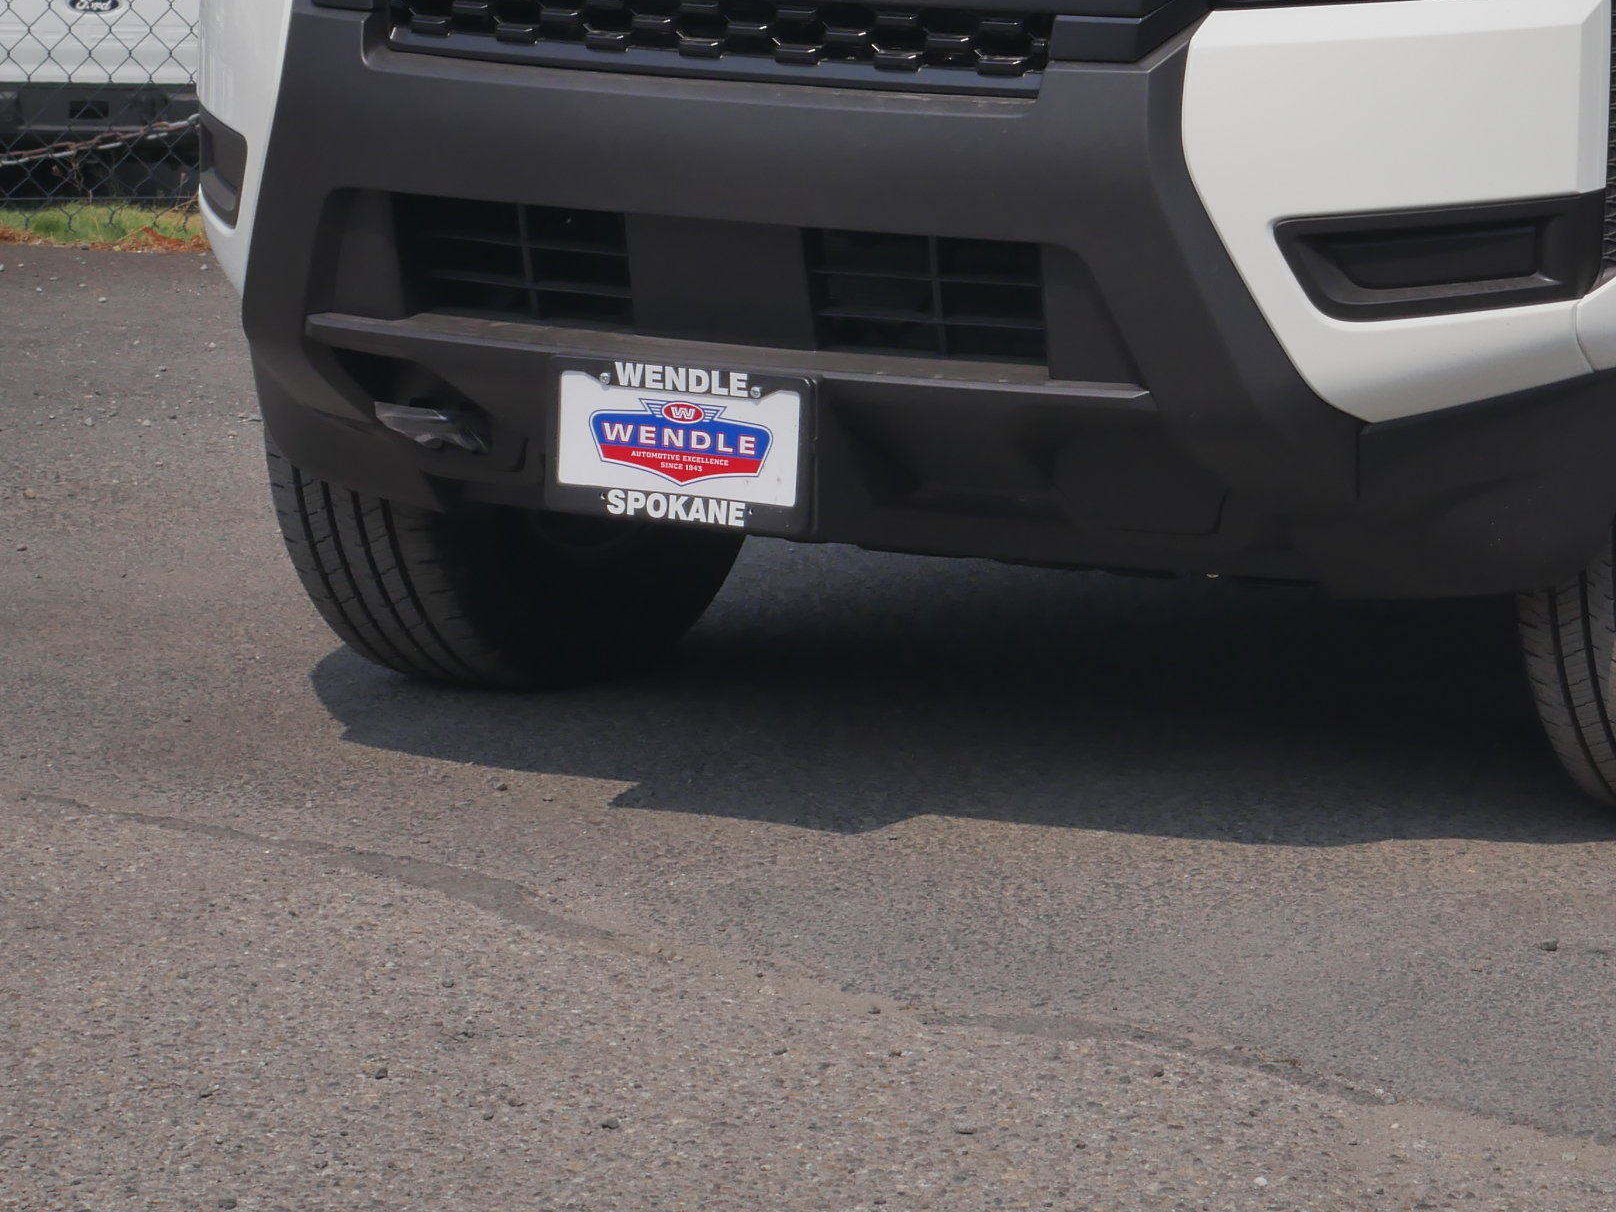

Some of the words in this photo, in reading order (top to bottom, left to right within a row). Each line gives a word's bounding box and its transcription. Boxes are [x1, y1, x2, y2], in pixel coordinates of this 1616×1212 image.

[615, 362, 749, 397] WENDLE
[603, 422, 756, 455] WENDLE
[631, 450, 680, 462] AUTOMOTIVE
[683, 455, 729, 466] EXCELLENCE
[660, 462, 684, 471] SINCE
[685, 464, 703, 473] 1943
[606, 489, 746, 527] SPOKANE
